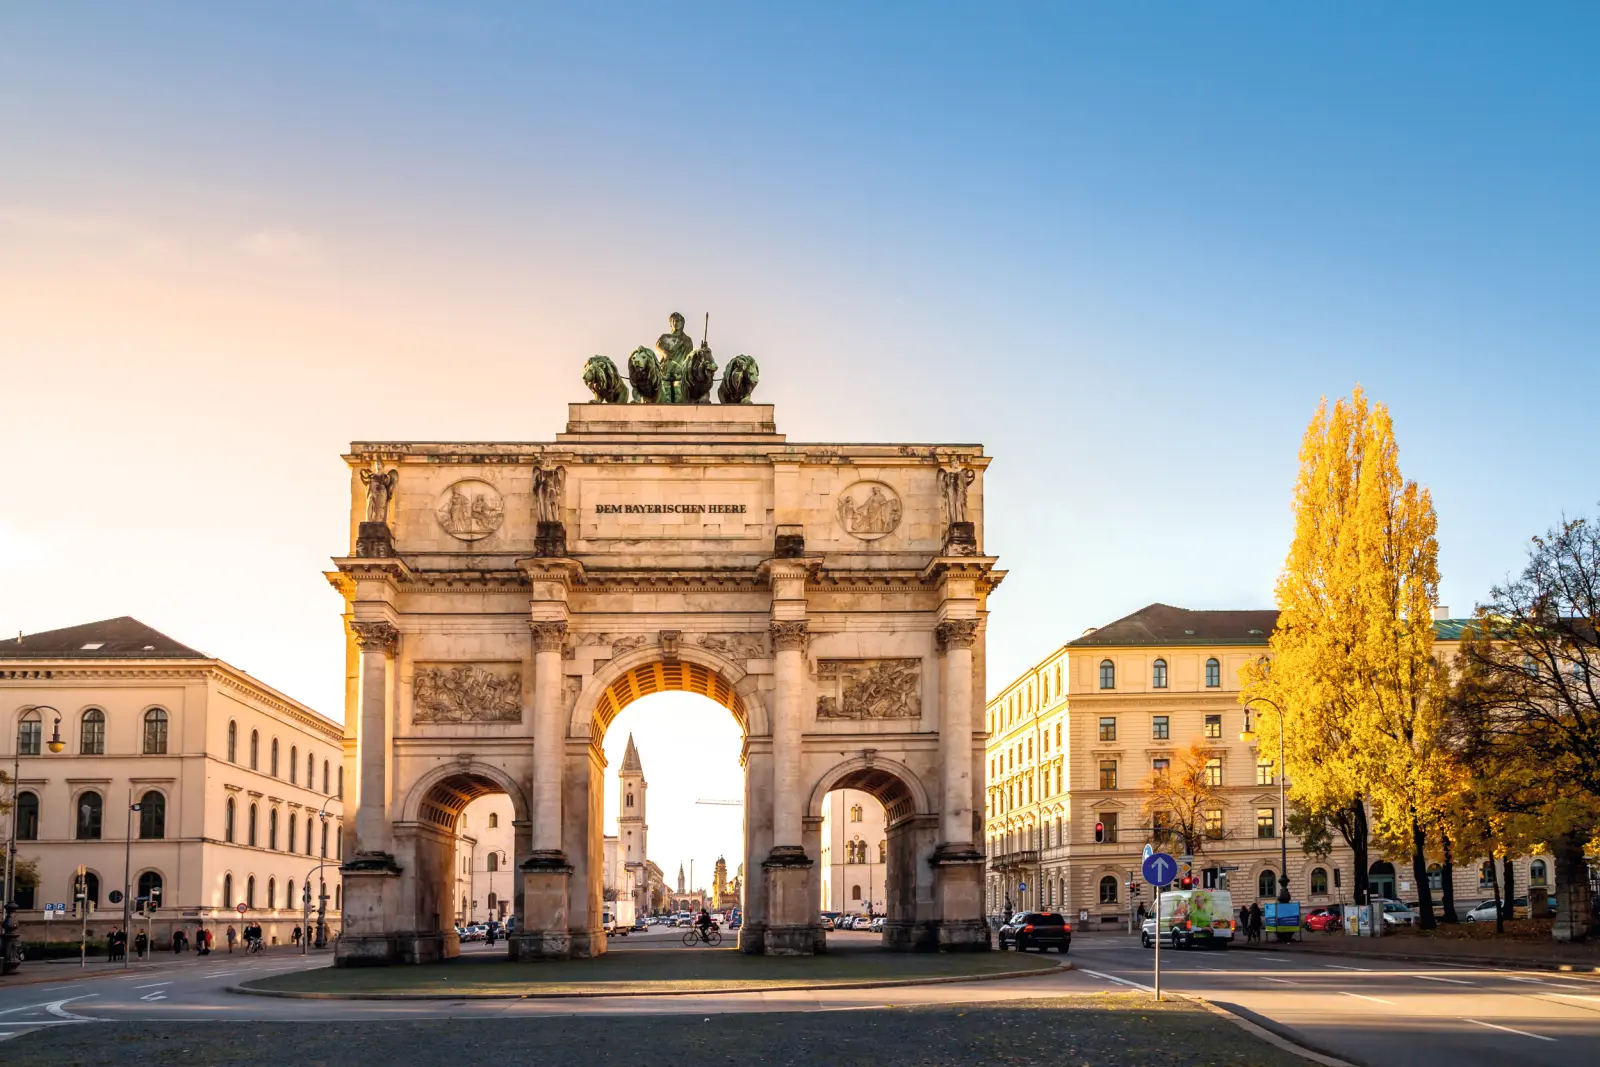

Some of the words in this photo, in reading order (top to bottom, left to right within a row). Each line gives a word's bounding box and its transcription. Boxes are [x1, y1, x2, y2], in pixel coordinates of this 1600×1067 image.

[595, 504, 622, 513] DEM
[624, 504, 705, 513] BAYERISCHEN
[708, 504, 746, 513] HEERE
